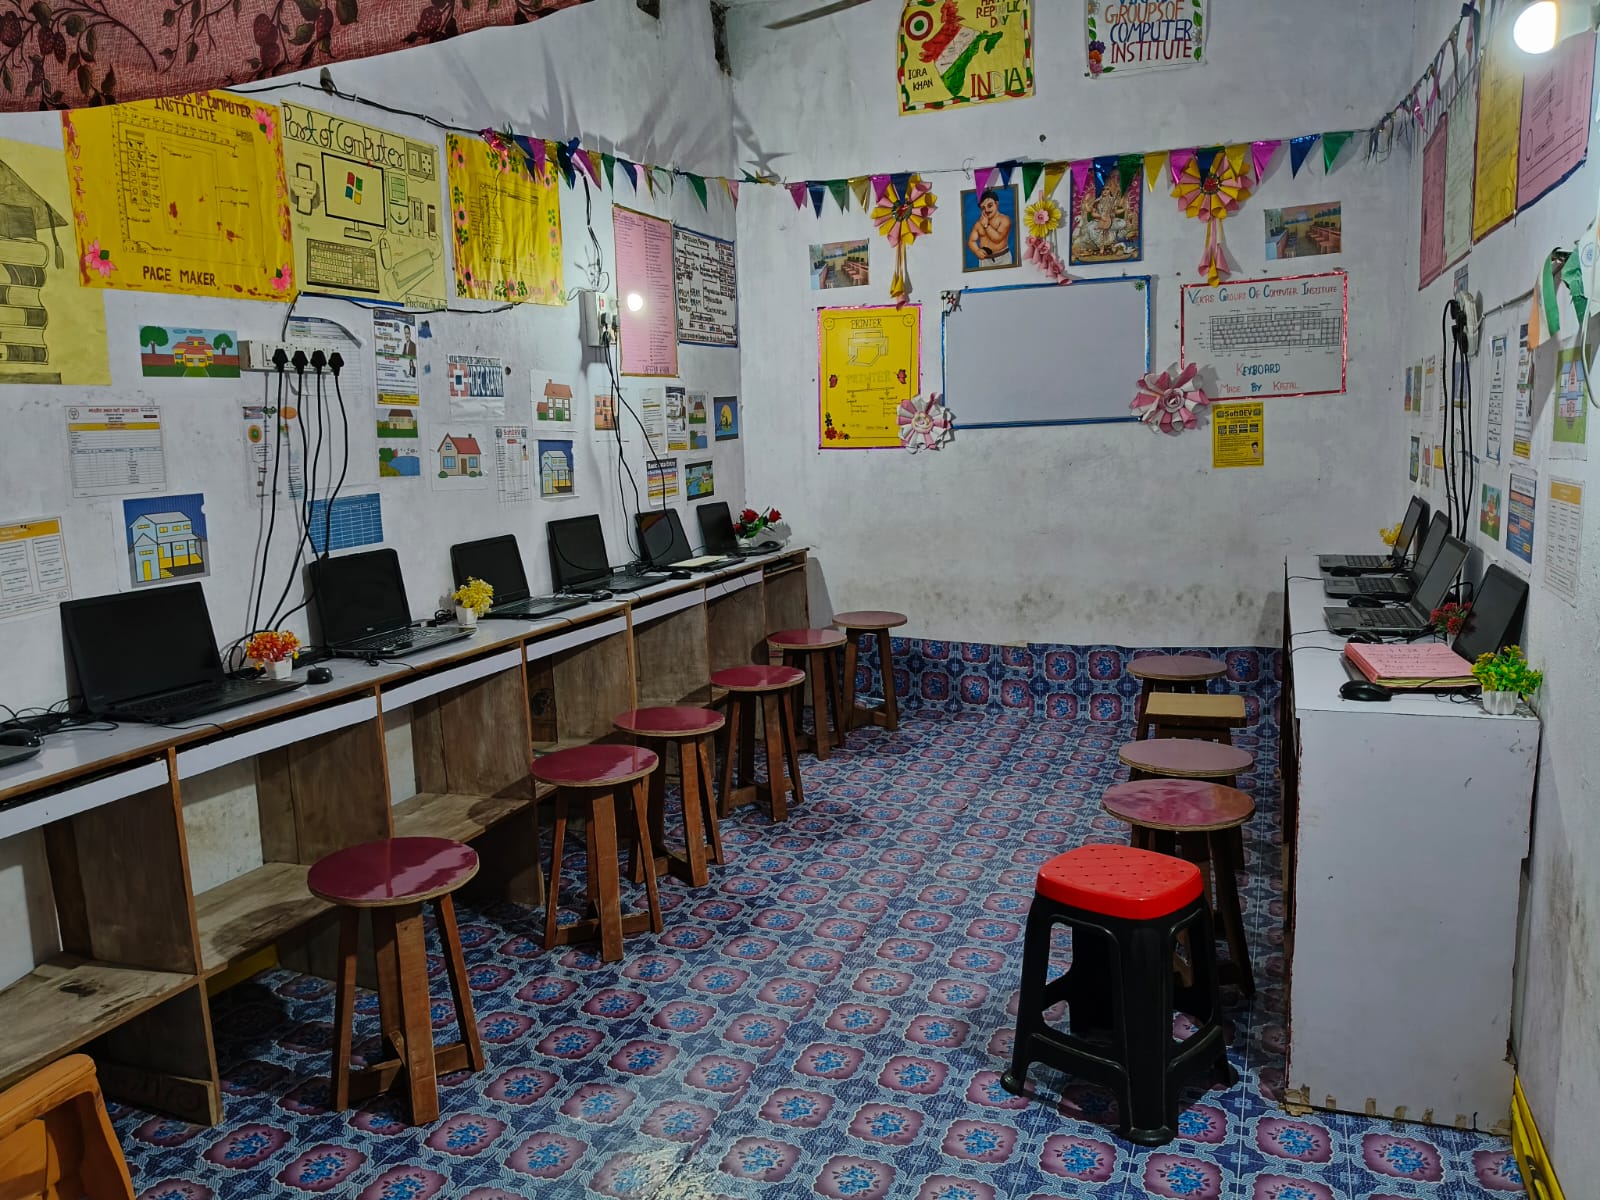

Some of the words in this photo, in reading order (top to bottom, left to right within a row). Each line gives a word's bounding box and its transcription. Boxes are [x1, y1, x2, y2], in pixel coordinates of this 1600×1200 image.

[1105, 2, 1164, 25] GROUPS
[1166, 0, 1184, 21] OF
[1110, 19, 1192, 43] COMPUTER
[1111, 39, 1192, 64] INSTITUTE
[912, 78, 933, 92] KHAN
[970, 67, 1025, 98] INDIA
[154, 97, 218, 122] INSTITUTE
[207, 95, 254, 119] COMPUTER
[283, 105, 318, 144] Part
[319, 118, 335, 149] of
[336, 122, 404, 167] Computer
[143, 265, 171, 281] PAGE
[179, 269, 217, 286] MAKER
[1188, 289, 1215, 304] VIKAS
[1263, 284, 1299, 298] COMPUTER
[1301, 282, 1337, 296] INSTITUTE
[851, 318, 882, 328] PRINTER
[468, 365, 485, 396] HDFC
[486, 366, 503, 396] BANK
[1236, 363, 1281, 376] KEYBOARD
[1250, 382, 1262, 392] BY
